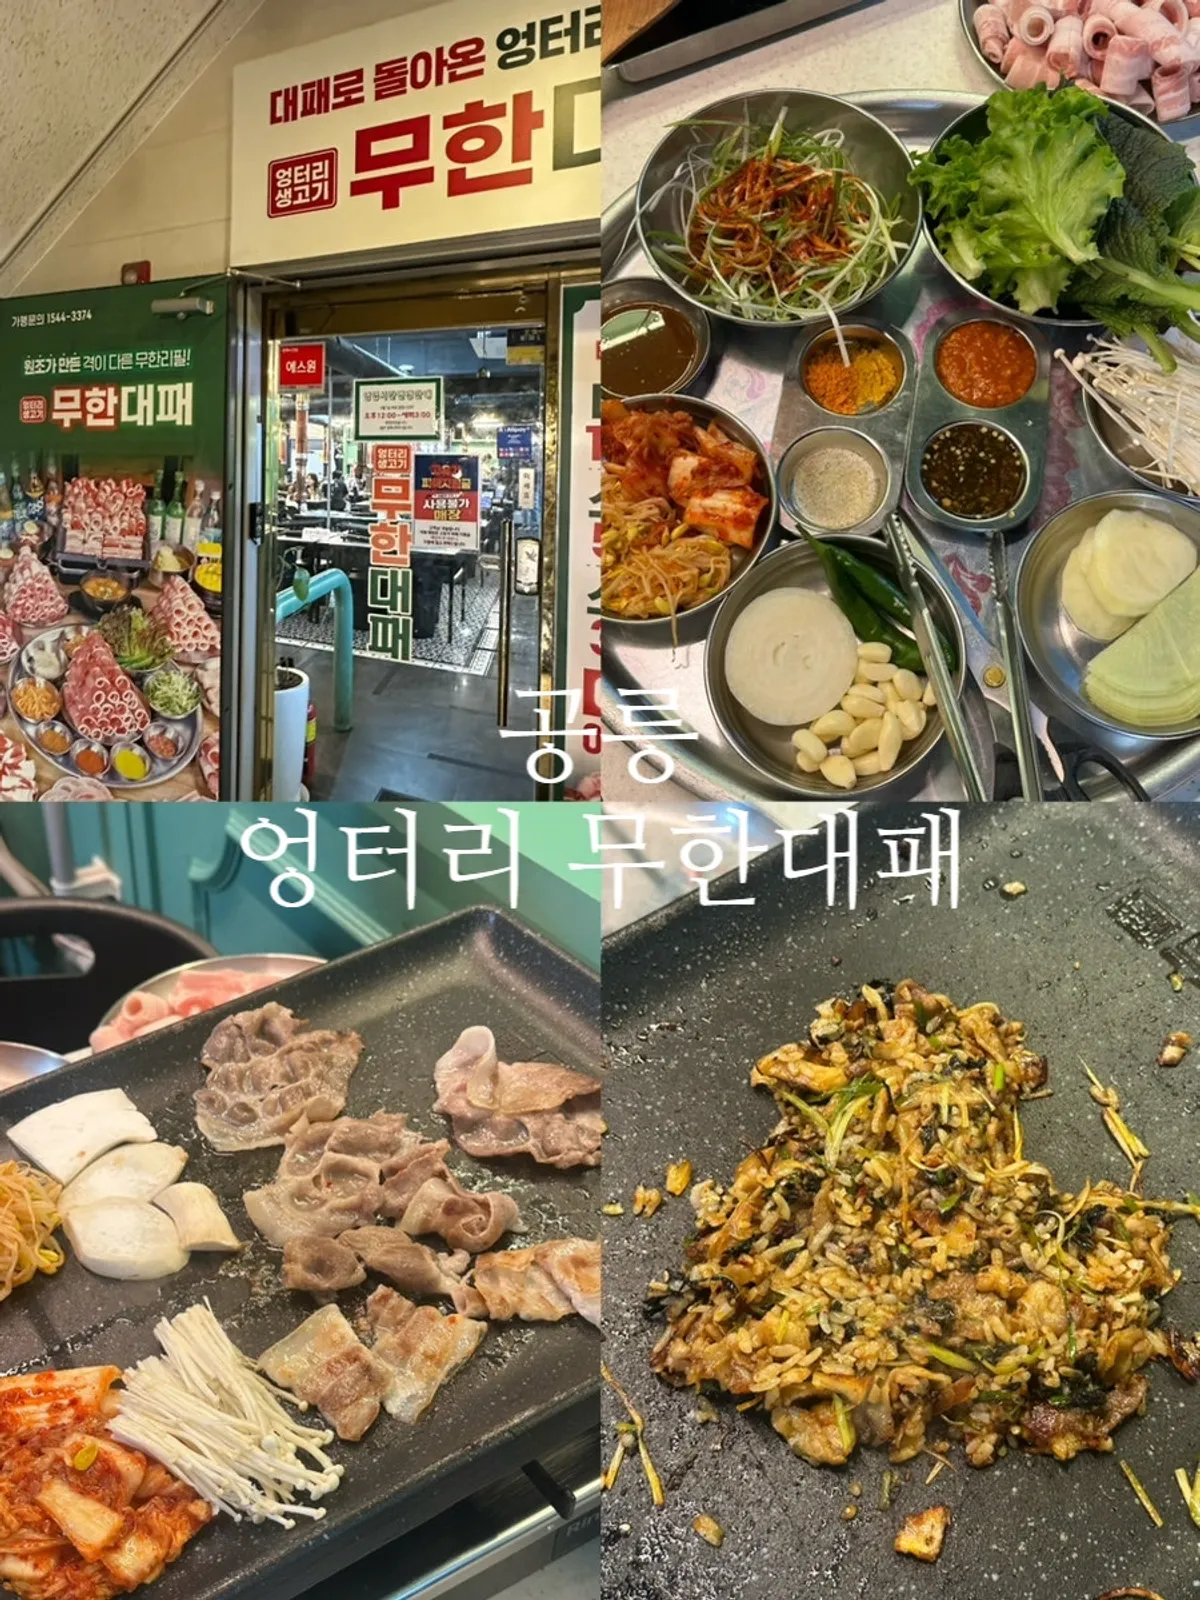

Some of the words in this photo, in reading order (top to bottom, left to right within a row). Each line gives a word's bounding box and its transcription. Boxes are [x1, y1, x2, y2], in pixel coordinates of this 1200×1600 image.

[269, 67, 365, 126] 대패로
[373, 36, 487, 102] 돌아온
[275, 159, 329, 188] 엉터리
[275, 180, 331, 209] 생고기
[11, 314, 45, 328] 가맹문의
[46, 309, 93, 325] 1544-3374
[23, 355, 57, 376] 원조가
[58, 354, 81, 374] 만든
[83, 354, 107, 372] 격이
[108, 353, 134, 371] 다른
[135, 348, 191, 369] 무한리필!
[285, 359, 317, 374] 에스원
[51, 382, 193, 428] 무한대패
[376, 447, 408, 461] 엉터리
[376, 459, 408, 470] 생고기
[423, 497, 470, 511] 사용불가
[433, 509, 461, 521] 매장
[368, 477, 414, 663] 무한대패
